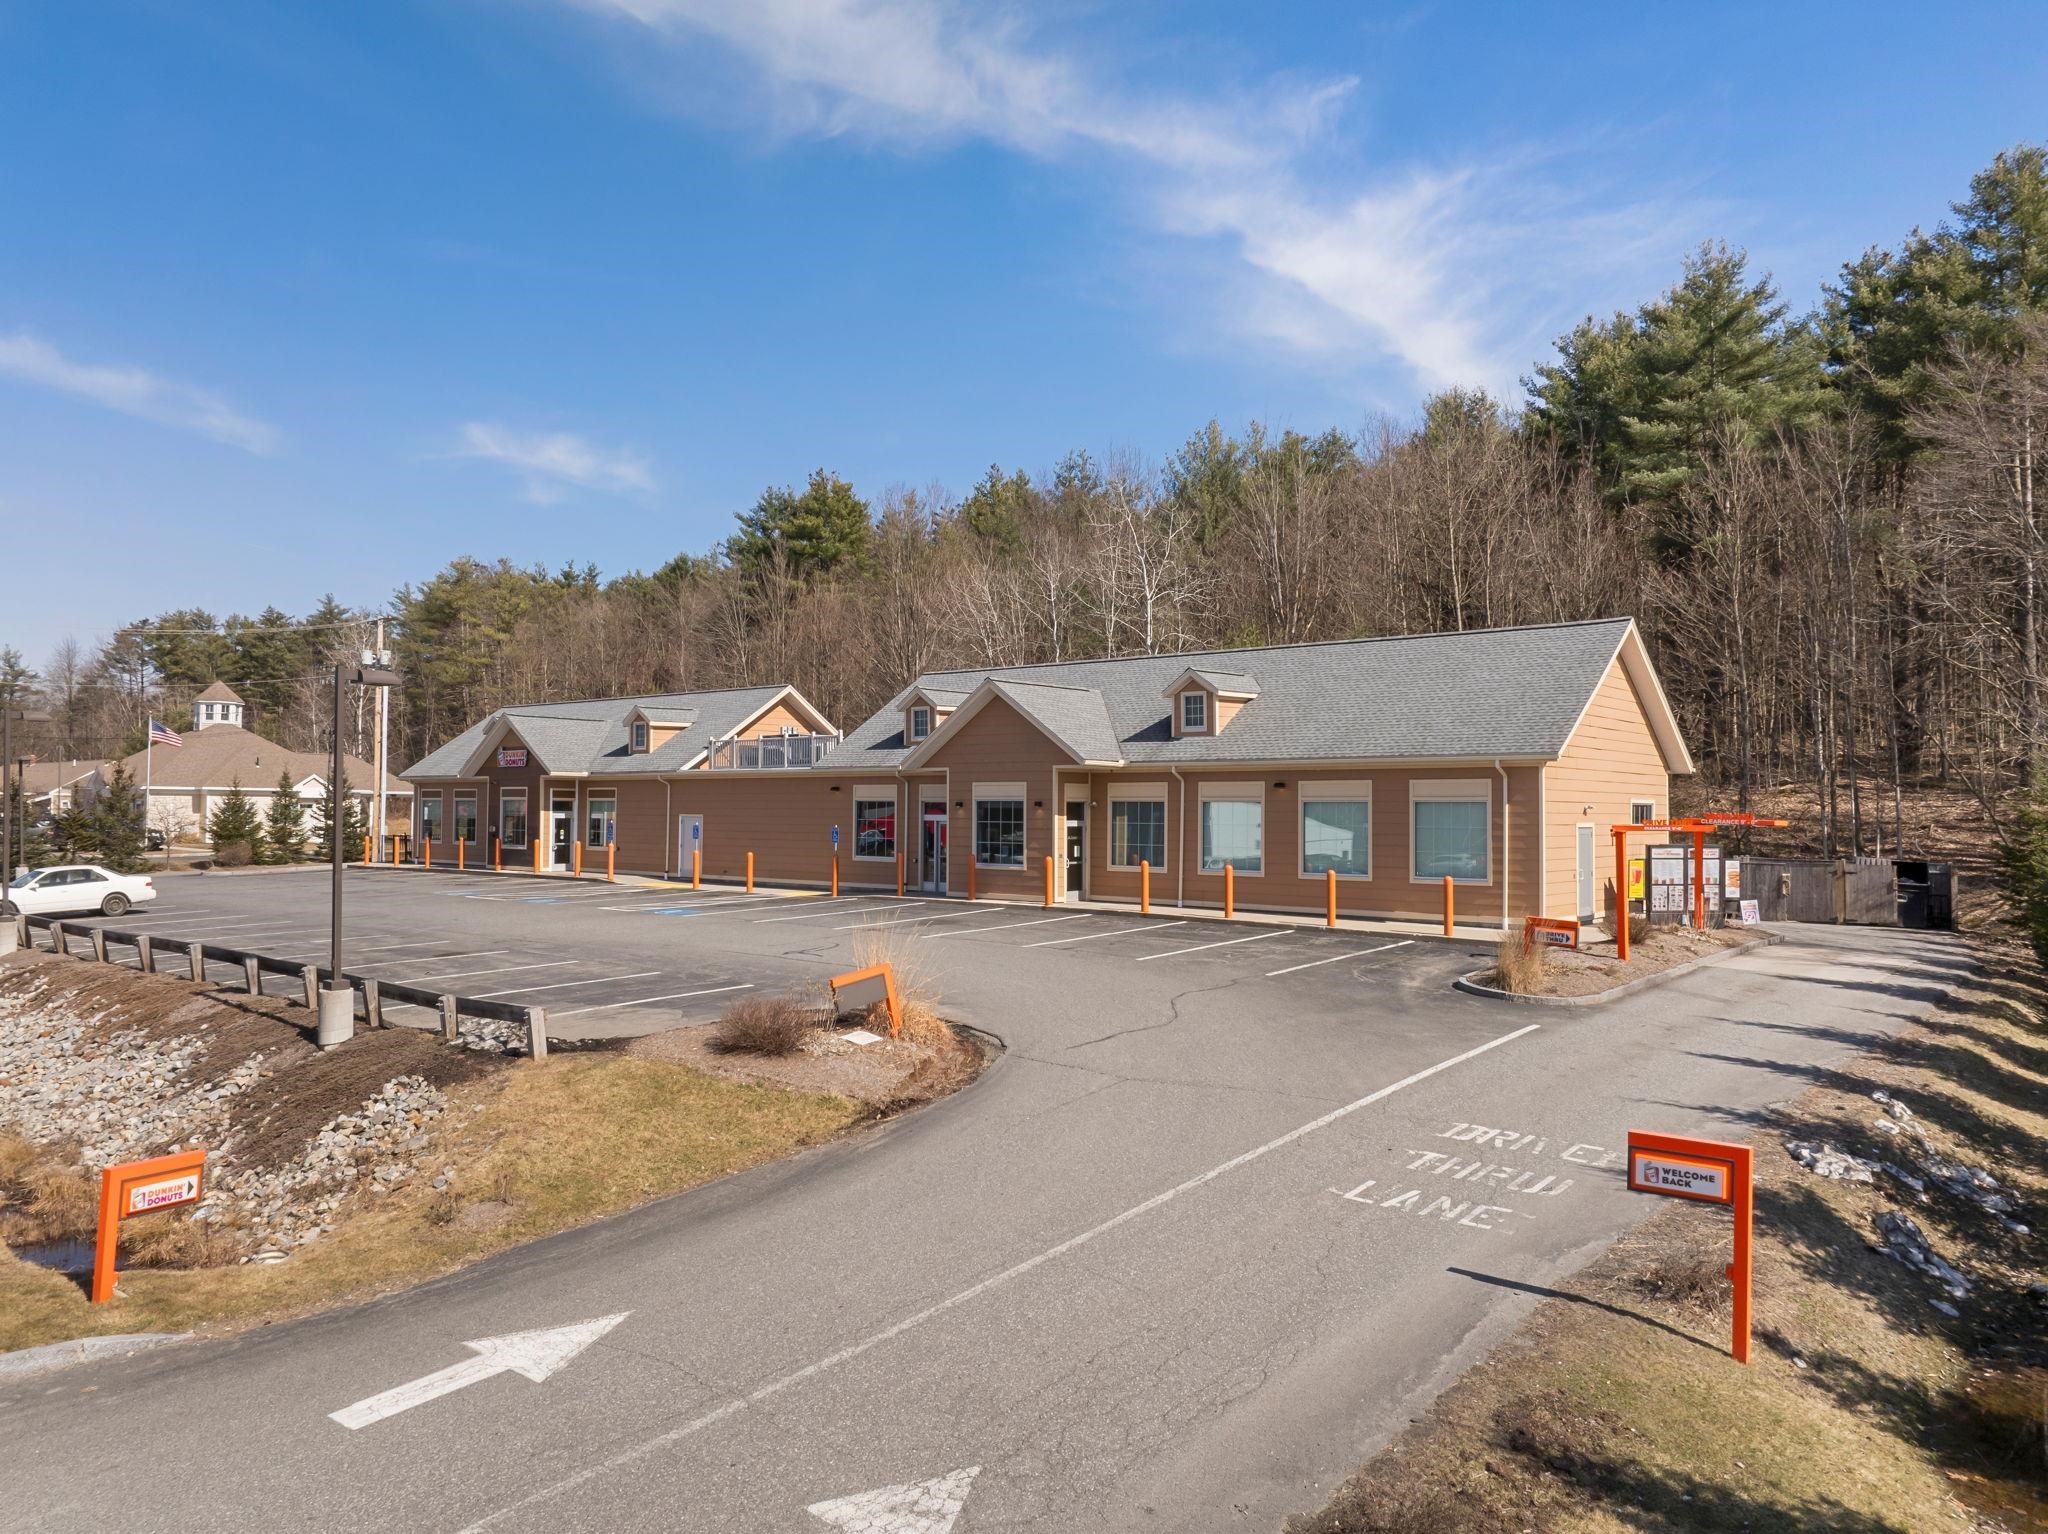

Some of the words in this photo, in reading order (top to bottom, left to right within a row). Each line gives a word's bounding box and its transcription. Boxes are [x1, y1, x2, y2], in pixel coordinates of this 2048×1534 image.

[1661, 1167, 1716, 1183] WELCOME
[1661, 1176, 1693, 1189] BACK
[147, 1183, 186, 1198] DUNKIN'
[147, 1191, 183, 1206] DONUTS
